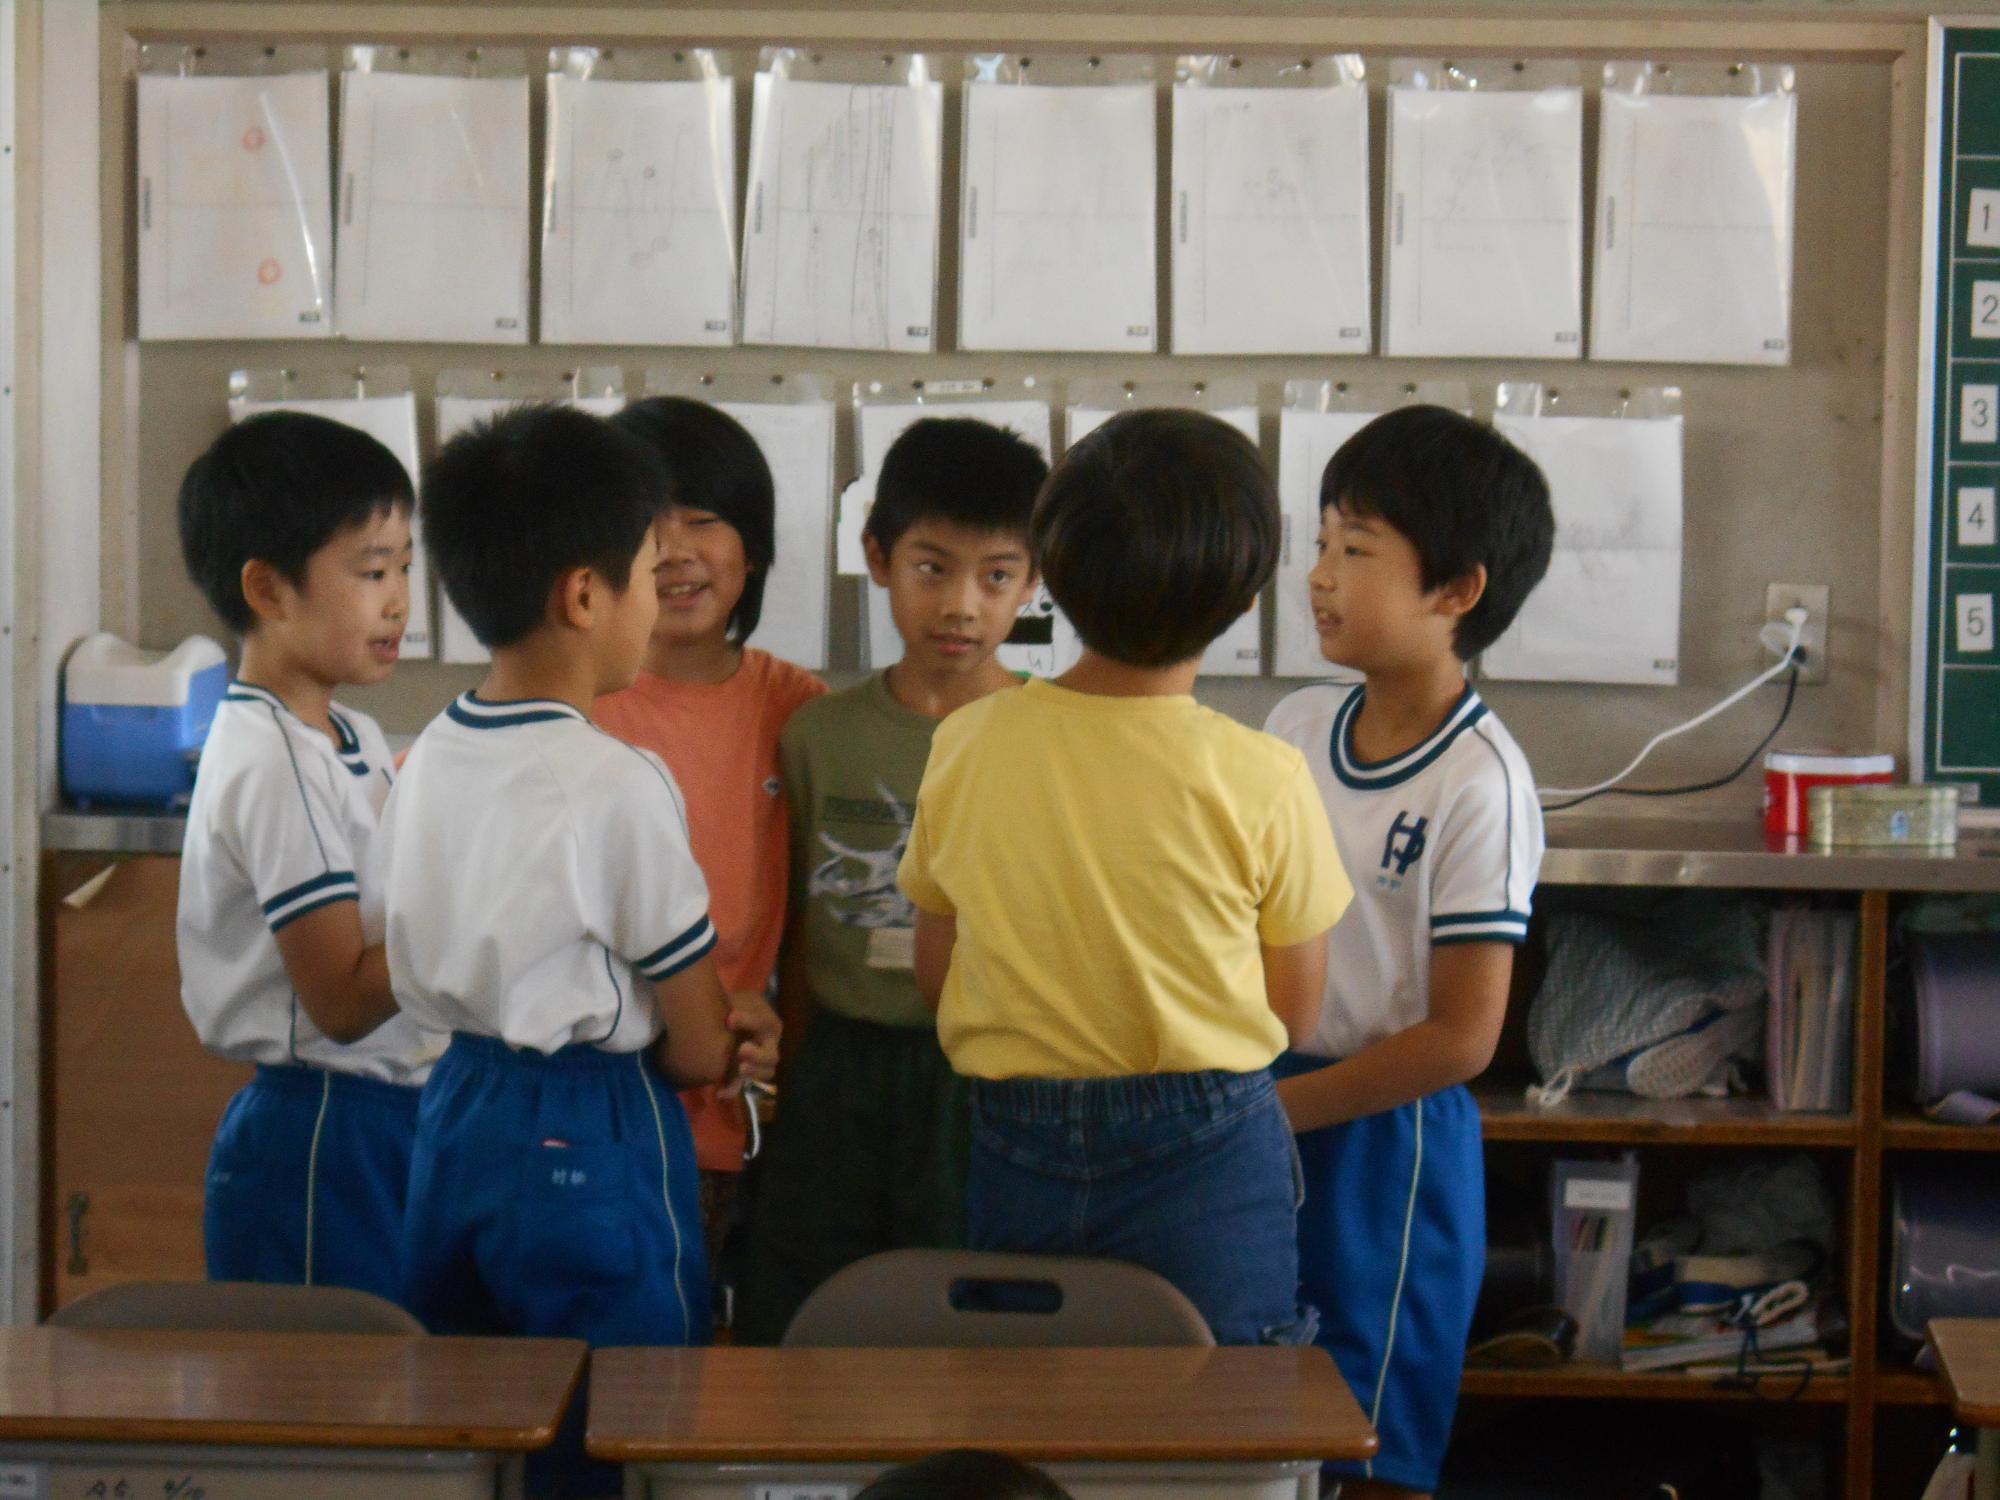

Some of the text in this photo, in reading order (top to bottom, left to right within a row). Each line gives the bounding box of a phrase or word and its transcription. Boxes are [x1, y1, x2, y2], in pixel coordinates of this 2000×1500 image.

[1982, 202, 1991, 232] 1
[1981, 293, 1999, 324] 2
[1970, 398, 1988, 429] 3
[1967, 502, 1986, 531] 4
[1966, 607, 1984, 638] 5
